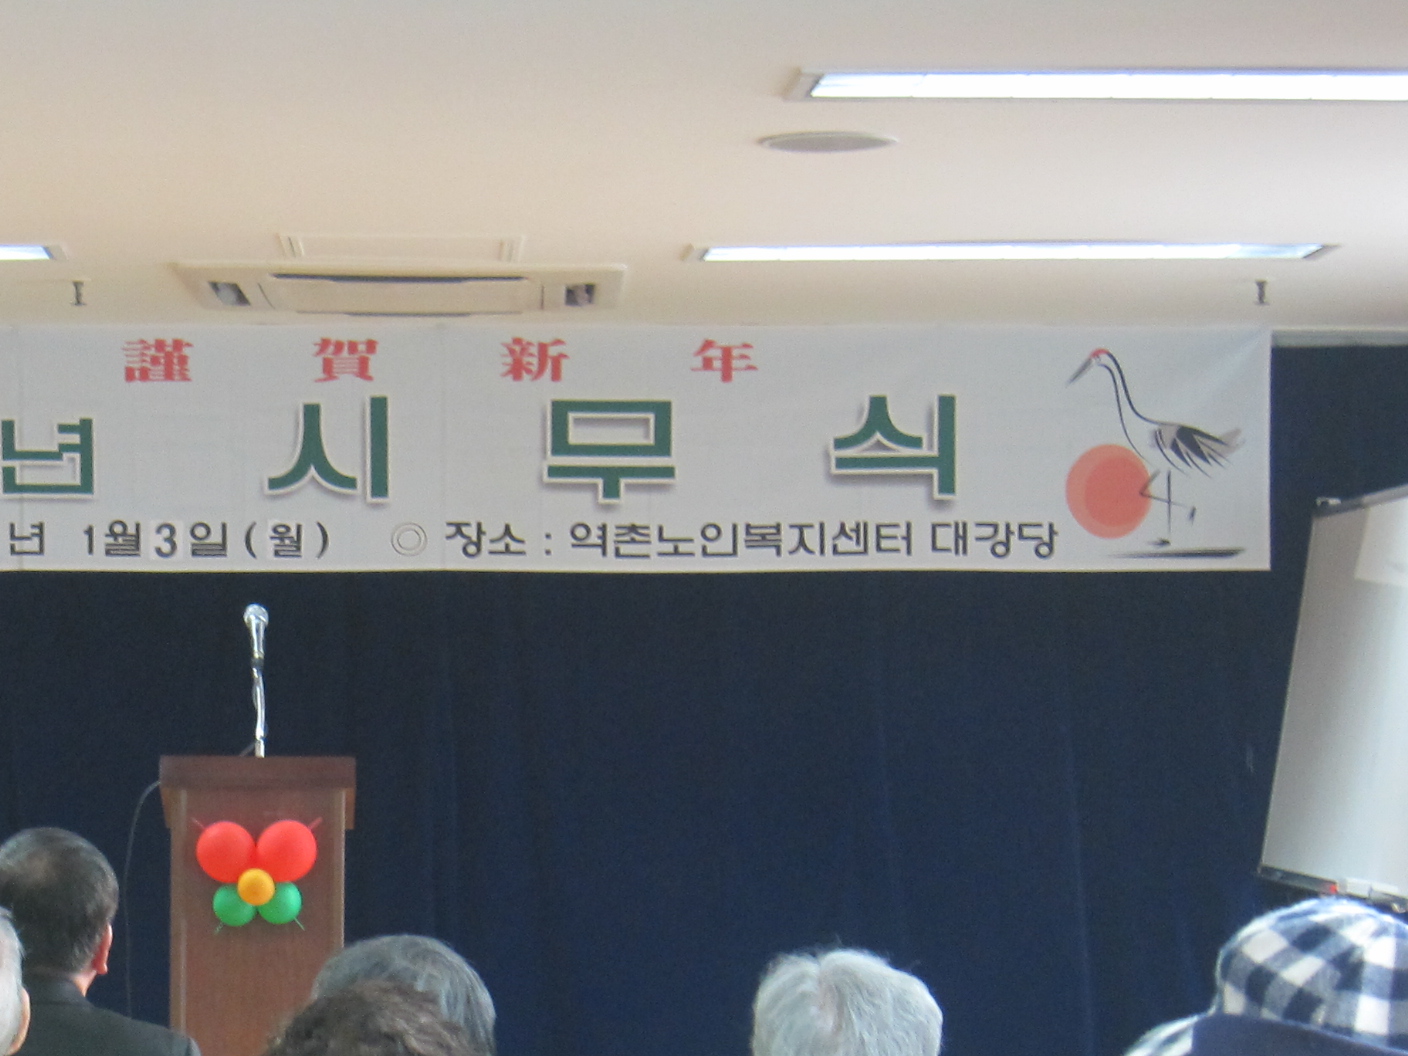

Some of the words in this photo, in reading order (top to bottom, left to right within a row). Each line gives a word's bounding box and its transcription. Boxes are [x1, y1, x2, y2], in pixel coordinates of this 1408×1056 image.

[315, 336, 380, 384] 賀
[503, 336, 570, 384] 新
[693, 338, 759, 384] 年
[569, 520, 914, 559] 역촌노인복지센터
[929, 520, 1059, 560] 대강당
